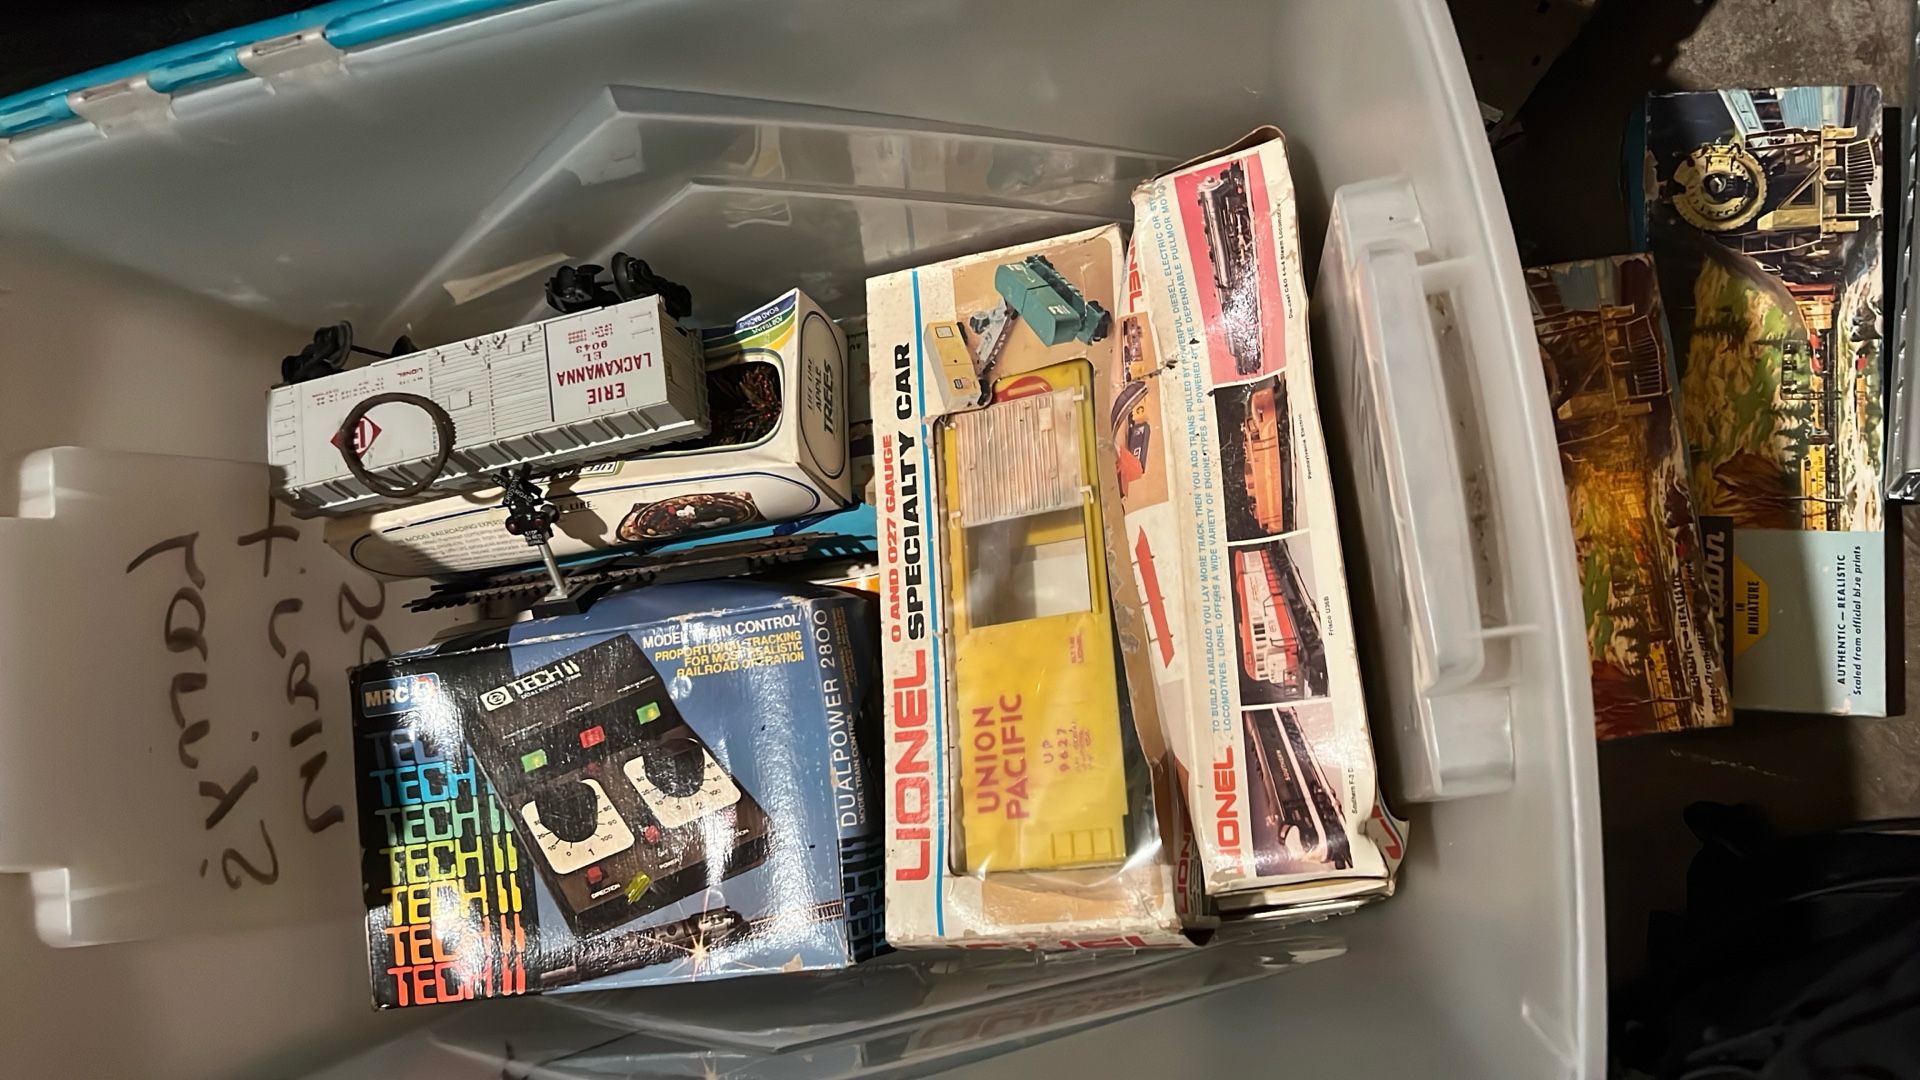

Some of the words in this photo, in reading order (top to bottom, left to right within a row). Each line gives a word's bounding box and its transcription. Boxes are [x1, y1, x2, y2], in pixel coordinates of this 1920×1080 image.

[1152, 216, 1161, 229] OR
[1155, 232, 1174, 276] ELECTRIC
[1164, 217, 1179, 260] PULLMOR
[1175, 264, 1192, 322] DEPENDABLE
[762, 306, 779, 318] ROAD
[575, 340, 608, 353] 9043
[583, 351, 602, 362] EL
[556, 352, 652, 386] LACKAWANNA
[894, 342, 913, 420] CAR
[1183, 367, 1191, 377] BY
[1193, 362, 1204, 403] POWERED
[587, 382, 625, 404] ERIE
[823, 359, 834, 435] TREES
[1184, 381, 1194, 412] PULLED
[1197, 406, 1206, 421] ALL
[1187, 415, 1197, 447] TRAINS
[1200, 426, 1208, 452] TYPES
[882, 434, 895, 512] GAUGE
[1190, 450, 1199, 468] ADD
[1192, 472, 1201, 490] YOU
[1194, 494, 1203, 516] THEN
[1205, 492, 1213, 504] OF
[898, 430, 925, 640] SPECIALTY
[1206, 508, 1216, 545] VARIETY
[1199, 555, 1208, 581] MORE
[1210, 548, 1219, 571] WIDE
[1853, 545, 1863, 573] prints
[889, 568, 900, 620] AND
[1201, 585, 1209, 602] LAY
[1837, 554, 1846, 609] REALISTIC
[1203, 605, 1212, 624] YOU
[1213, 585, 1222, 619] OFFERS
[1735, 602, 1746, 612] IN
[1747, 580, 1760, 635] MINIATURE
[643, 632, 688, 648] MODEL
[735, 614, 800, 634] CONTROL
[1853, 603, 1861, 634] official
[747, 631, 801, 646] TRACKING
[812, 609, 837, 668] 2800
[1205, 628, 1215, 675] RAILROAD
[1217, 624, 1225, 656] LIONEL
[1853, 636, 1862, 660] from
[676, 661, 739, 678] RAILROAD
[684, 656, 709, 667] FOR
[1837, 624, 1847, 685] AUTHENTIC
[507, 664, 564, 694] TECH
[1853, 663, 1862, 695] Scaled
[365, 686, 410, 708] MRC
[1209, 689, 1218, 716] BUILD
[846, 713, 859, 756] CONTROL
[1212, 720, 1220, 732] TO
[823, 678, 858, 828] DUALPOWER
[894, 650, 931, 881] LIONEL
[972, 706, 1001, 814] UNION
[999, 694, 1030, 820] PACIFIC
[1042, 740, 1054, 764] UP
[1057, 728, 1070, 772] 9627
[368, 757, 478, 807] TECH
[853, 758, 863, 789] TRAIN
[374, 794, 481, 846] TECH
[856, 791, 865, 824] MODEL
[588, 848, 595, 856] 1
[601, 834, 613, 842] 100
[380, 834, 483, 885] TECH
[382, 874, 489, 926] TECH
[591, 883, 621, 899] DIRECTION
